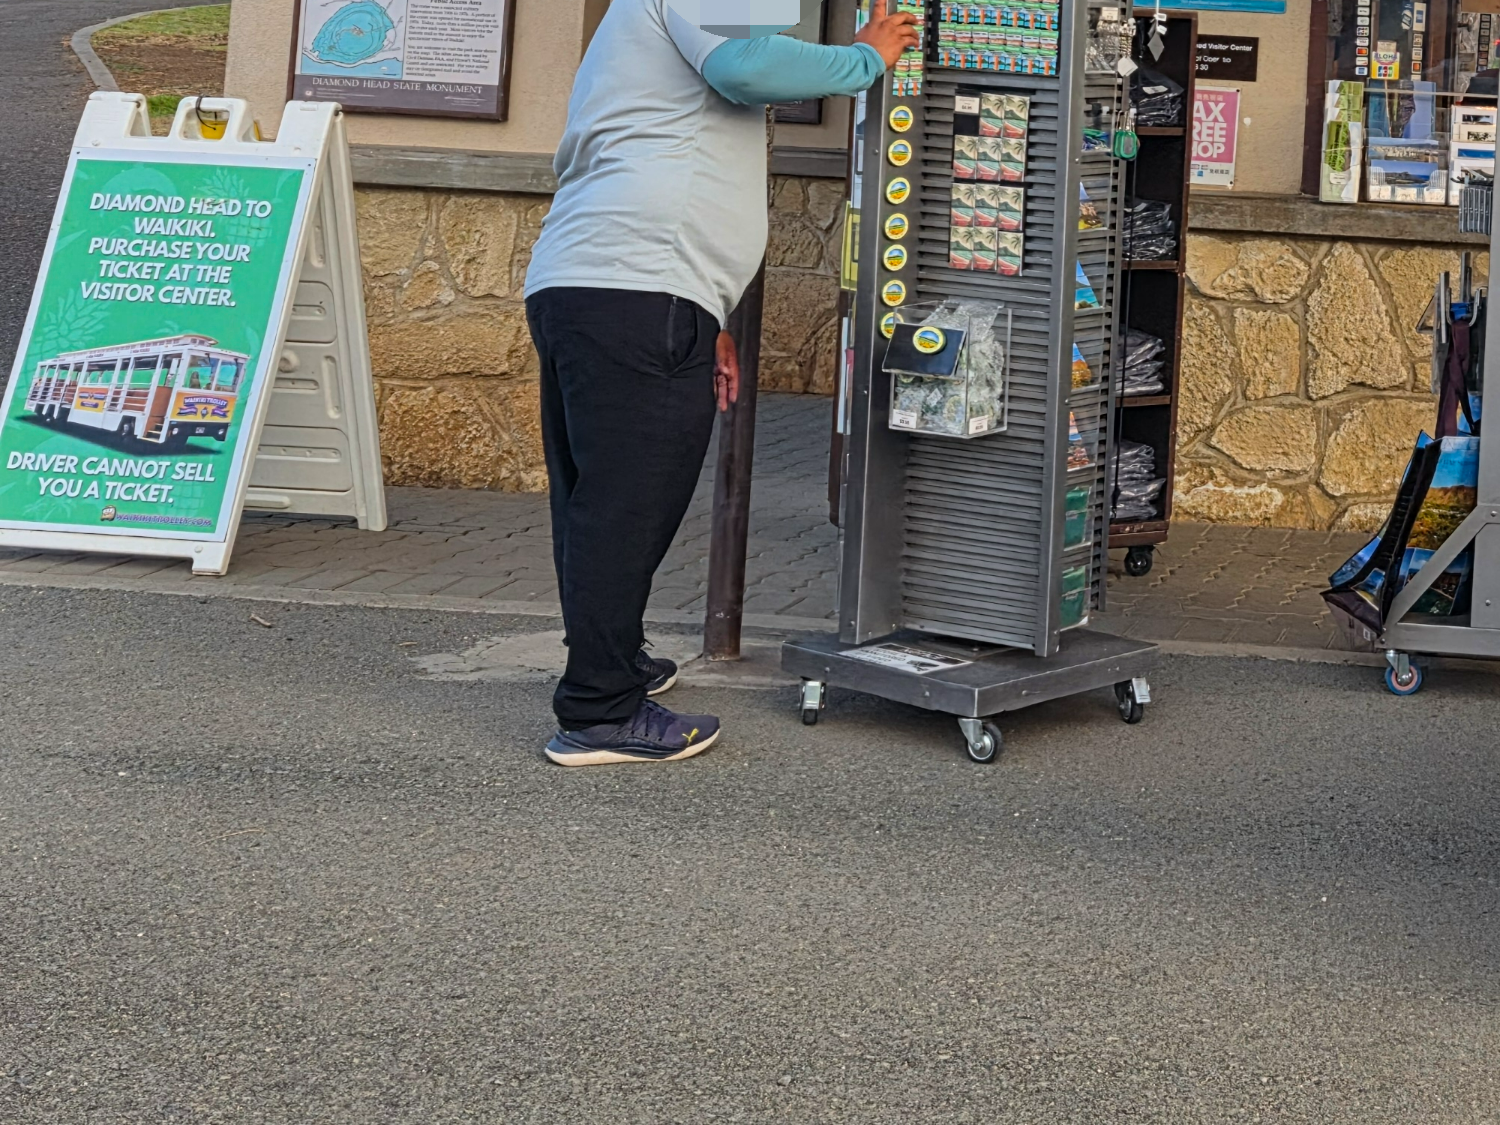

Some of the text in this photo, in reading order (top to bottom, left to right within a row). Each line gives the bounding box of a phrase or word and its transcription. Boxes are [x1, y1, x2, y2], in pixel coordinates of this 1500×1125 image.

[312, 77, 483, 95] DIAMOND HEAD STATE MONUMENT
[1192, 101, 1226, 122] AX
[1192, 122, 1227, 143] REE
[1192, 141, 1226, 159] HOP
[90, 192, 272, 218] DIAMOND HEAD TO
[134, 217, 216, 238] WAIKIKI.
[88, 237, 250, 263] PURCHASE YOUR
[99, 259, 232, 285] TICKET AT THE
[80, 281, 236, 308] VISITOR CENTER.
[6, 451, 216, 483] DRIVER CANNOT SELL
[38, 477, 174, 504] YOU A TICKET.
